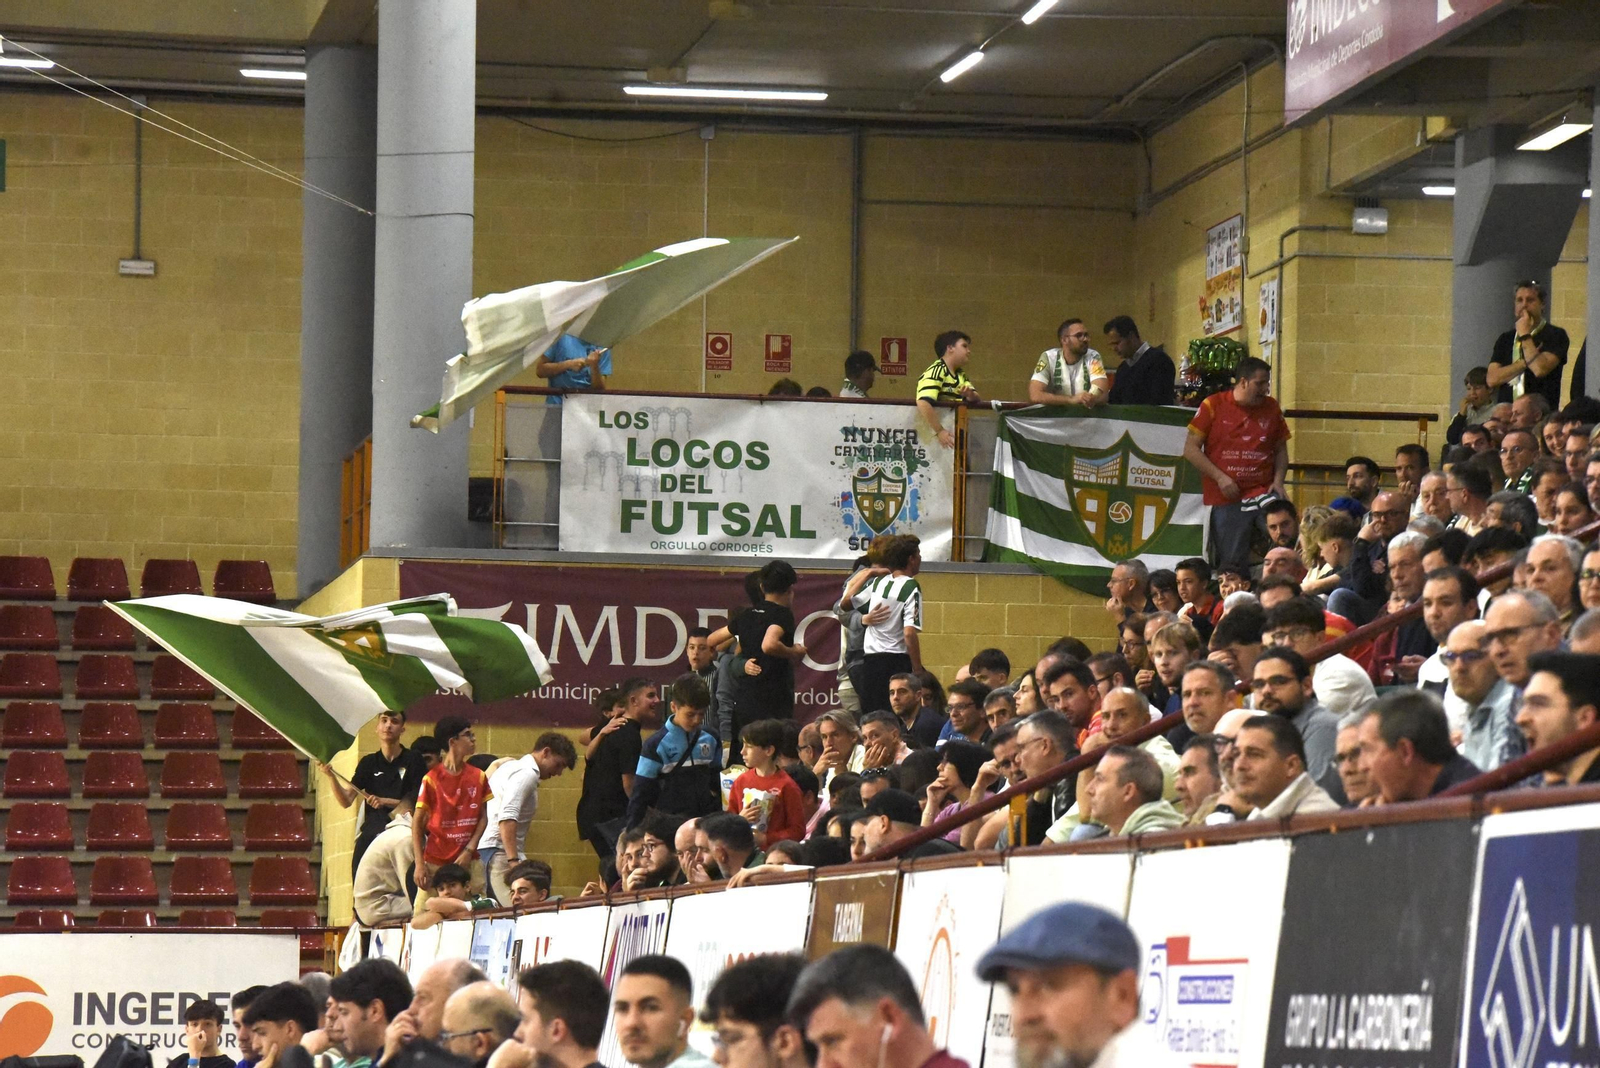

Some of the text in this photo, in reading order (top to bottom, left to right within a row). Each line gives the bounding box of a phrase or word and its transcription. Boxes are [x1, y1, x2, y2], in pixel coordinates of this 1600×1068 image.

[599, 410, 649, 430] LOS
[843, 426, 918, 445] NUNCA
[627, 437, 771, 471] LOCOS
[1130, 466, 1172, 478] CÓRDOBA
[1134, 476, 1167, 487] FUTSAL
[660, 473, 713, 494] DEL
[620, 499, 817, 539] FUTSAL
[650, 540, 773, 553] ORGULLO CORDOBÉS
